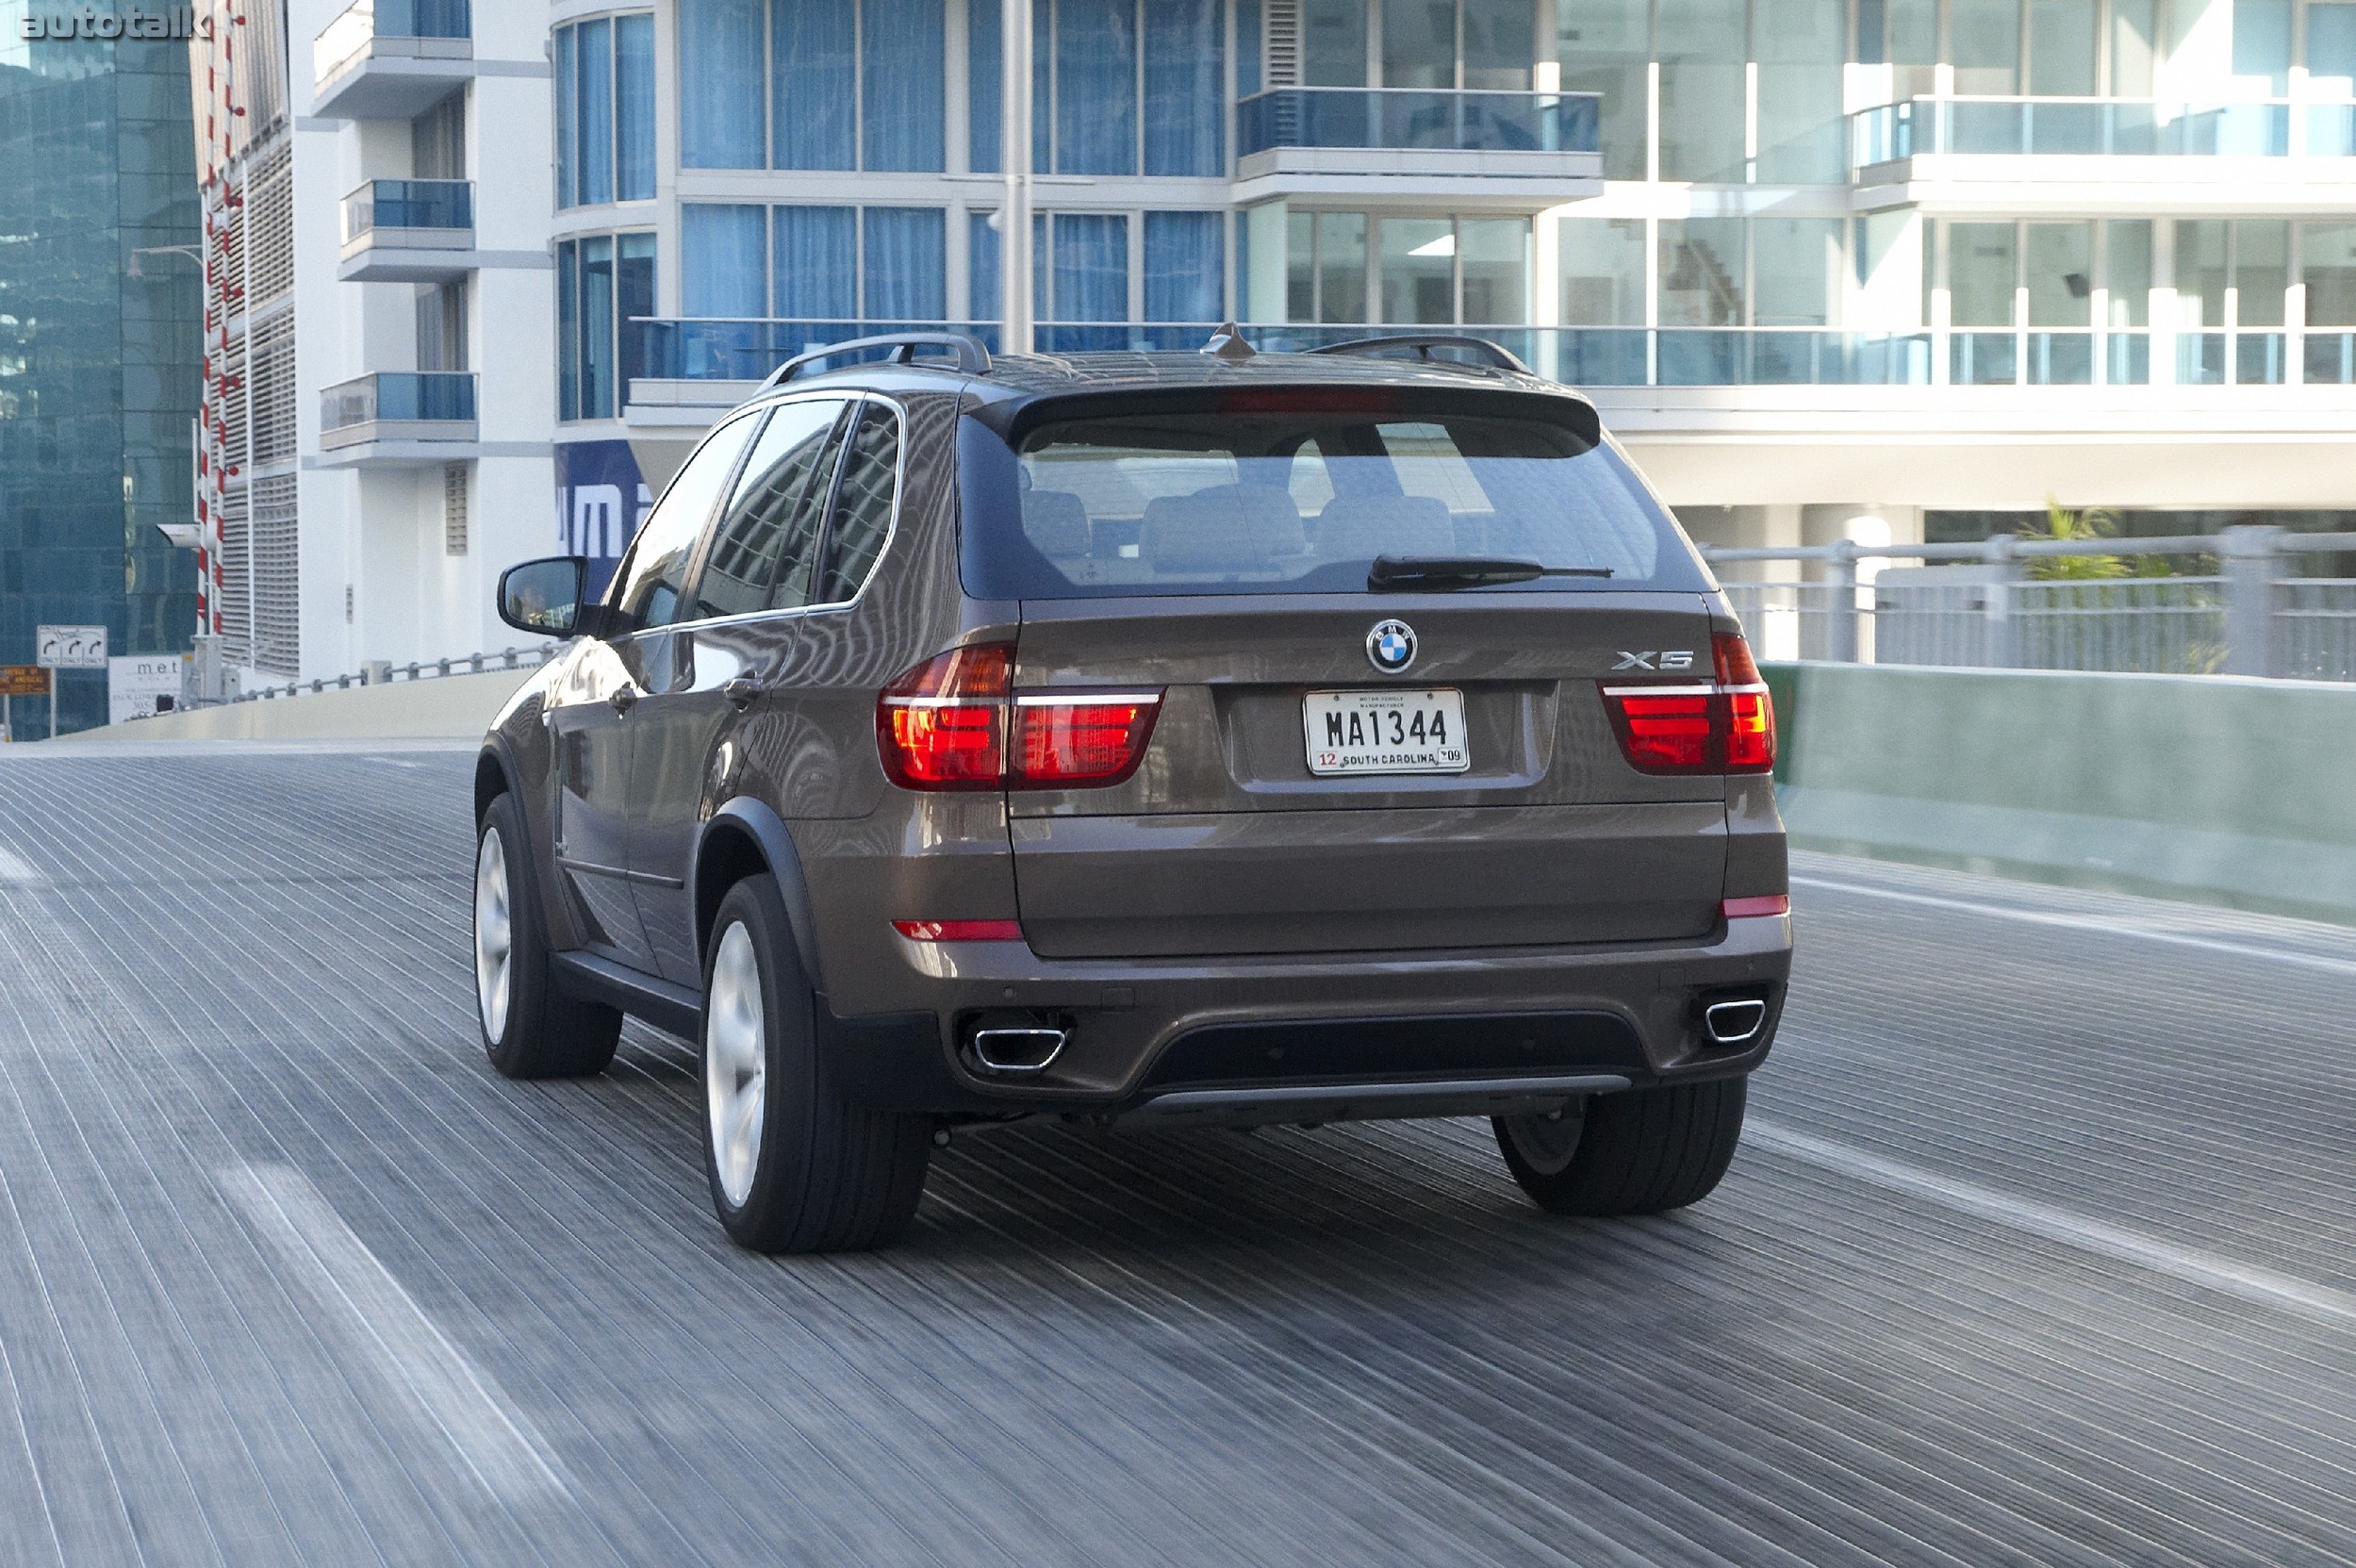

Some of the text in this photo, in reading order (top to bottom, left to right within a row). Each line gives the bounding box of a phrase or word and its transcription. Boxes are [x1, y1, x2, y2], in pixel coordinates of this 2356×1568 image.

[1376, 625, 1409, 640] BMW
[1611, 651, 1694, 669] X5
[1326, 710, 1446, 747] MA1344
[1320, 753, 1337, 766] 12
[1343, 753, 1435, 765] SOUTH CAROLINA
[1448, 750, 1460, 761] 09
